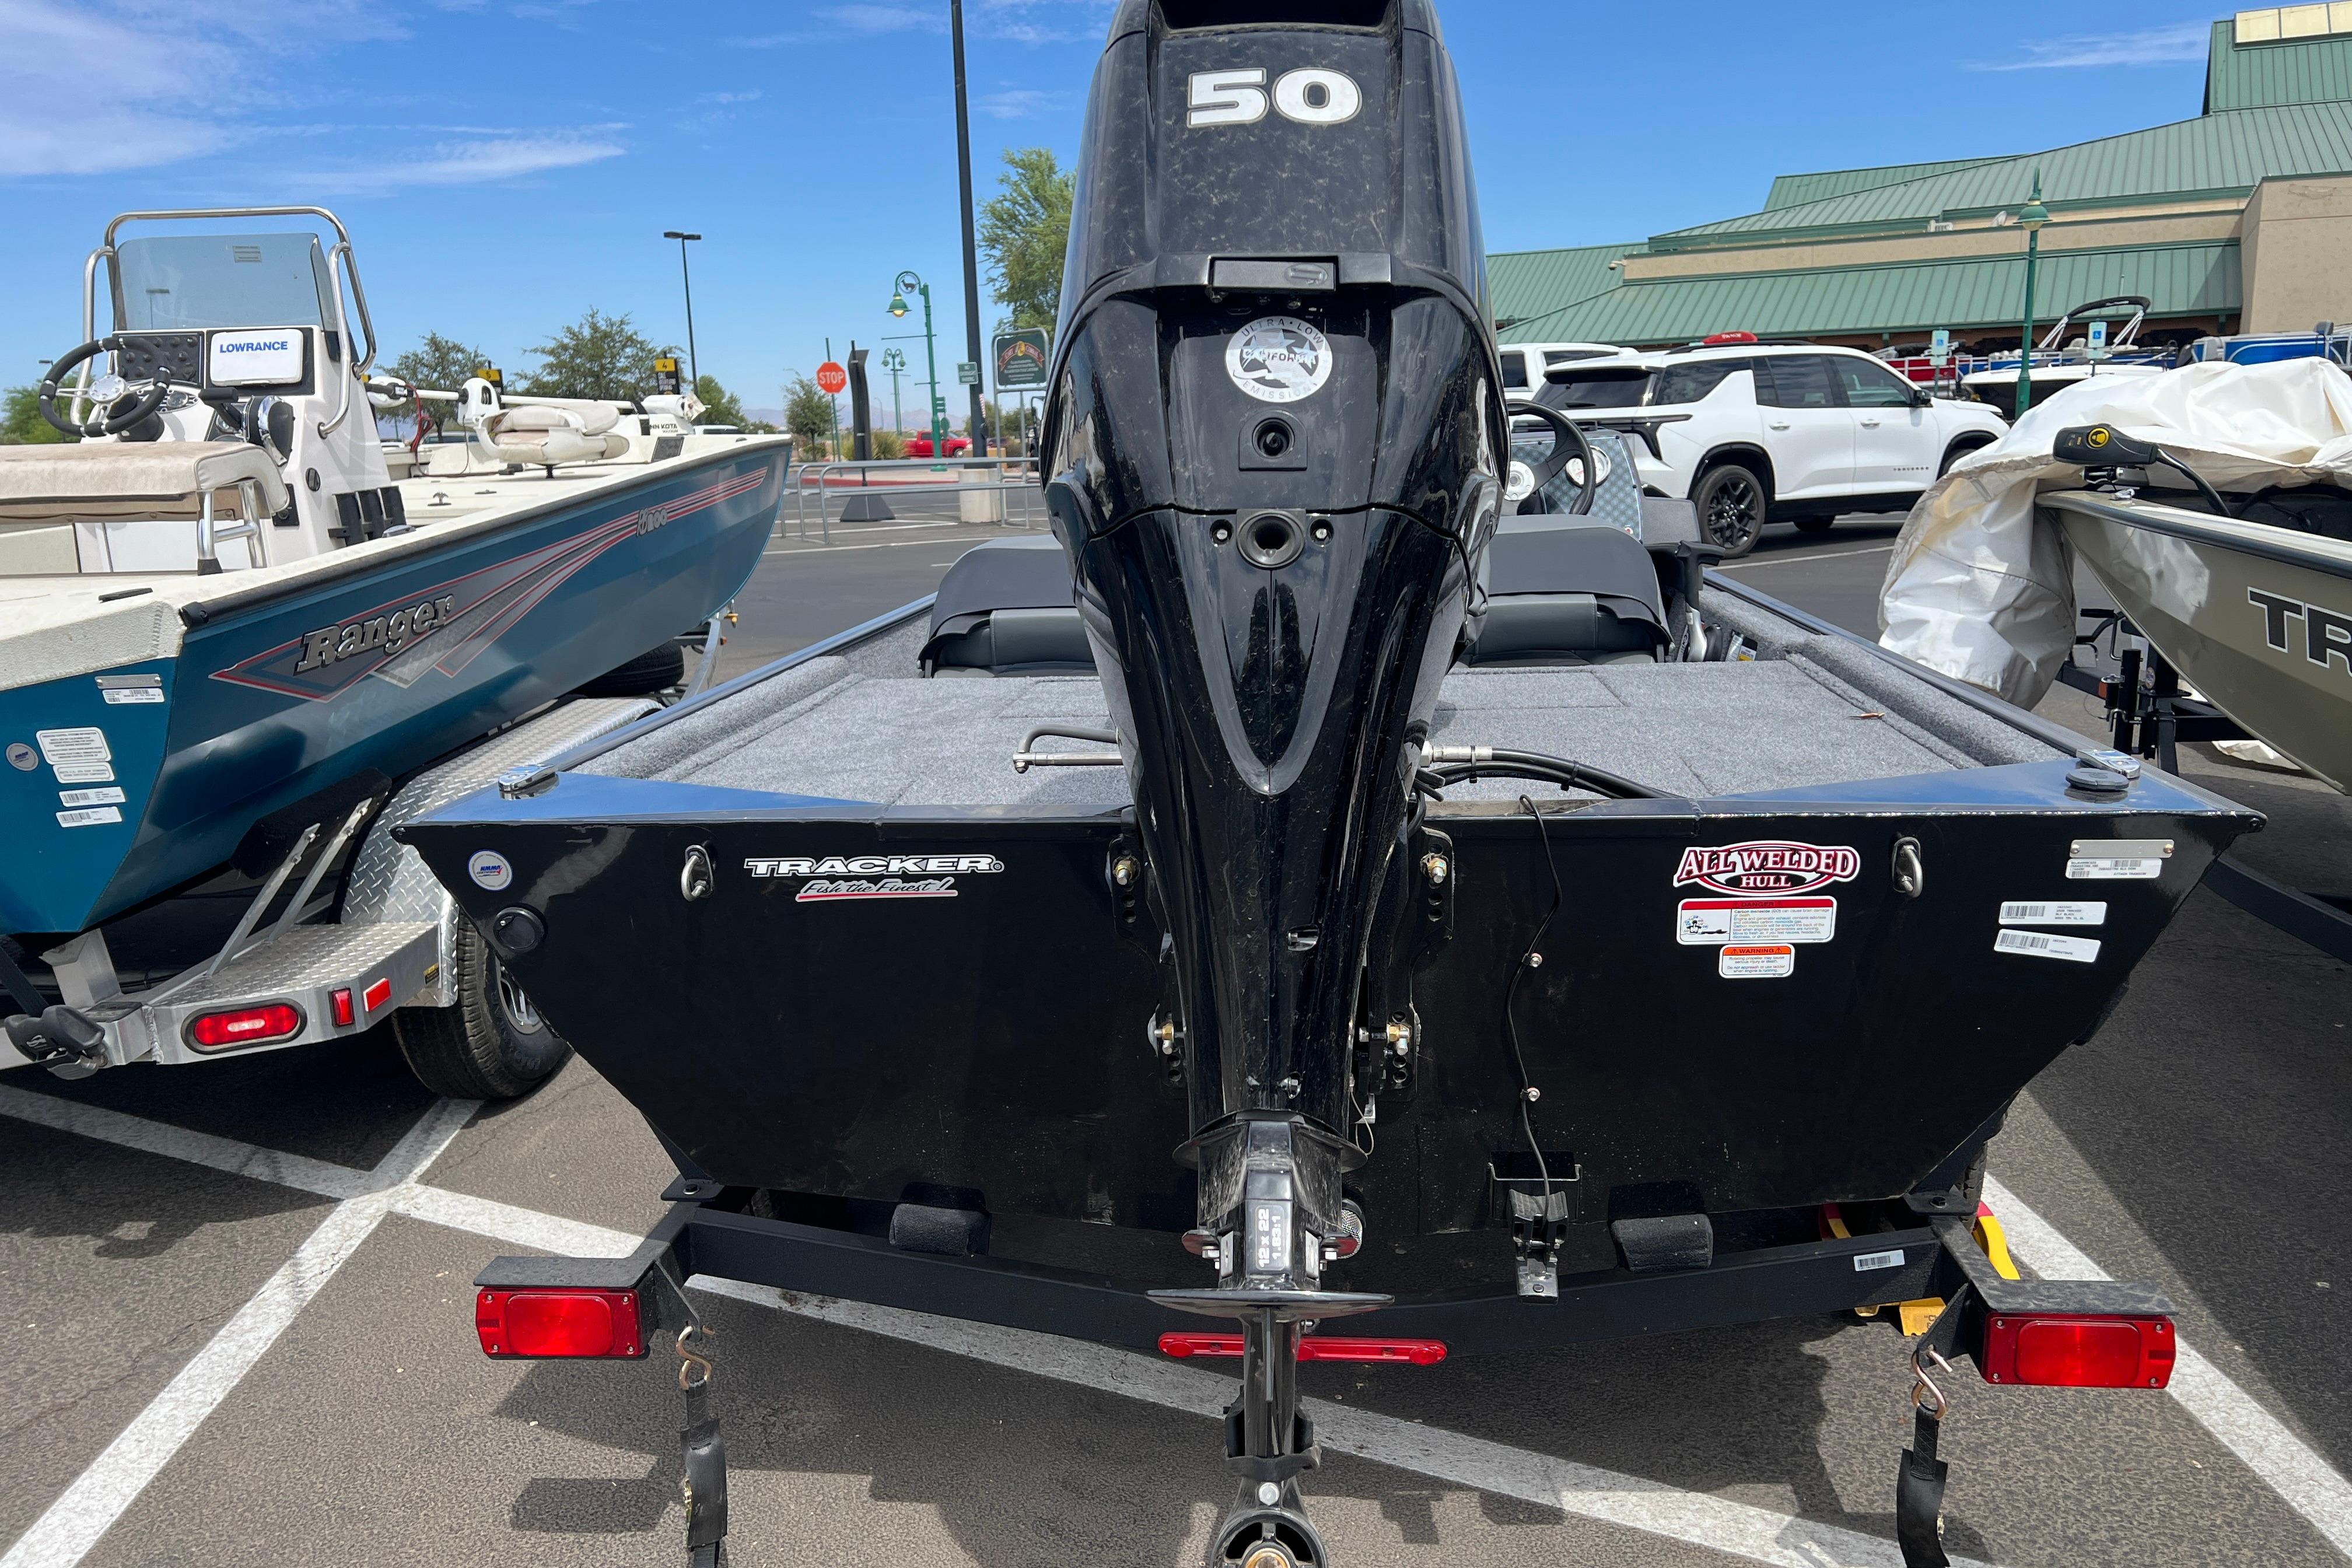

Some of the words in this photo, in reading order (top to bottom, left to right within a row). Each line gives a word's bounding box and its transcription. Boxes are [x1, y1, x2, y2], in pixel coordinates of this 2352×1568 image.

[1187, 66, 1363, 128] 50
[1241, 318, 1285, 337] ULTRA
[1297, 321, 1324, 344] LOW
[219, 341, 288, 353] LOWRANCE
[818, 371, 845, 384] STOP
[294, 594, 455, 676] Ranger
[745, 856, 994, 876] TRACKER
[1676, 849, 1740, 882] ALL
[1738, 848, 1859, 878] WELDED
[803, 882, 842, 894] Fish
[845, 881, 875, 893] the
[1740, 874, 1791, 888] HULL
[1258, 1208, 1269, 1231] 22
[1261, 1235, 1269, 1245] x
[1272, 1215, 1282, 1260] 1.83:1
[1258, 1247, 1270, 1268] 12
